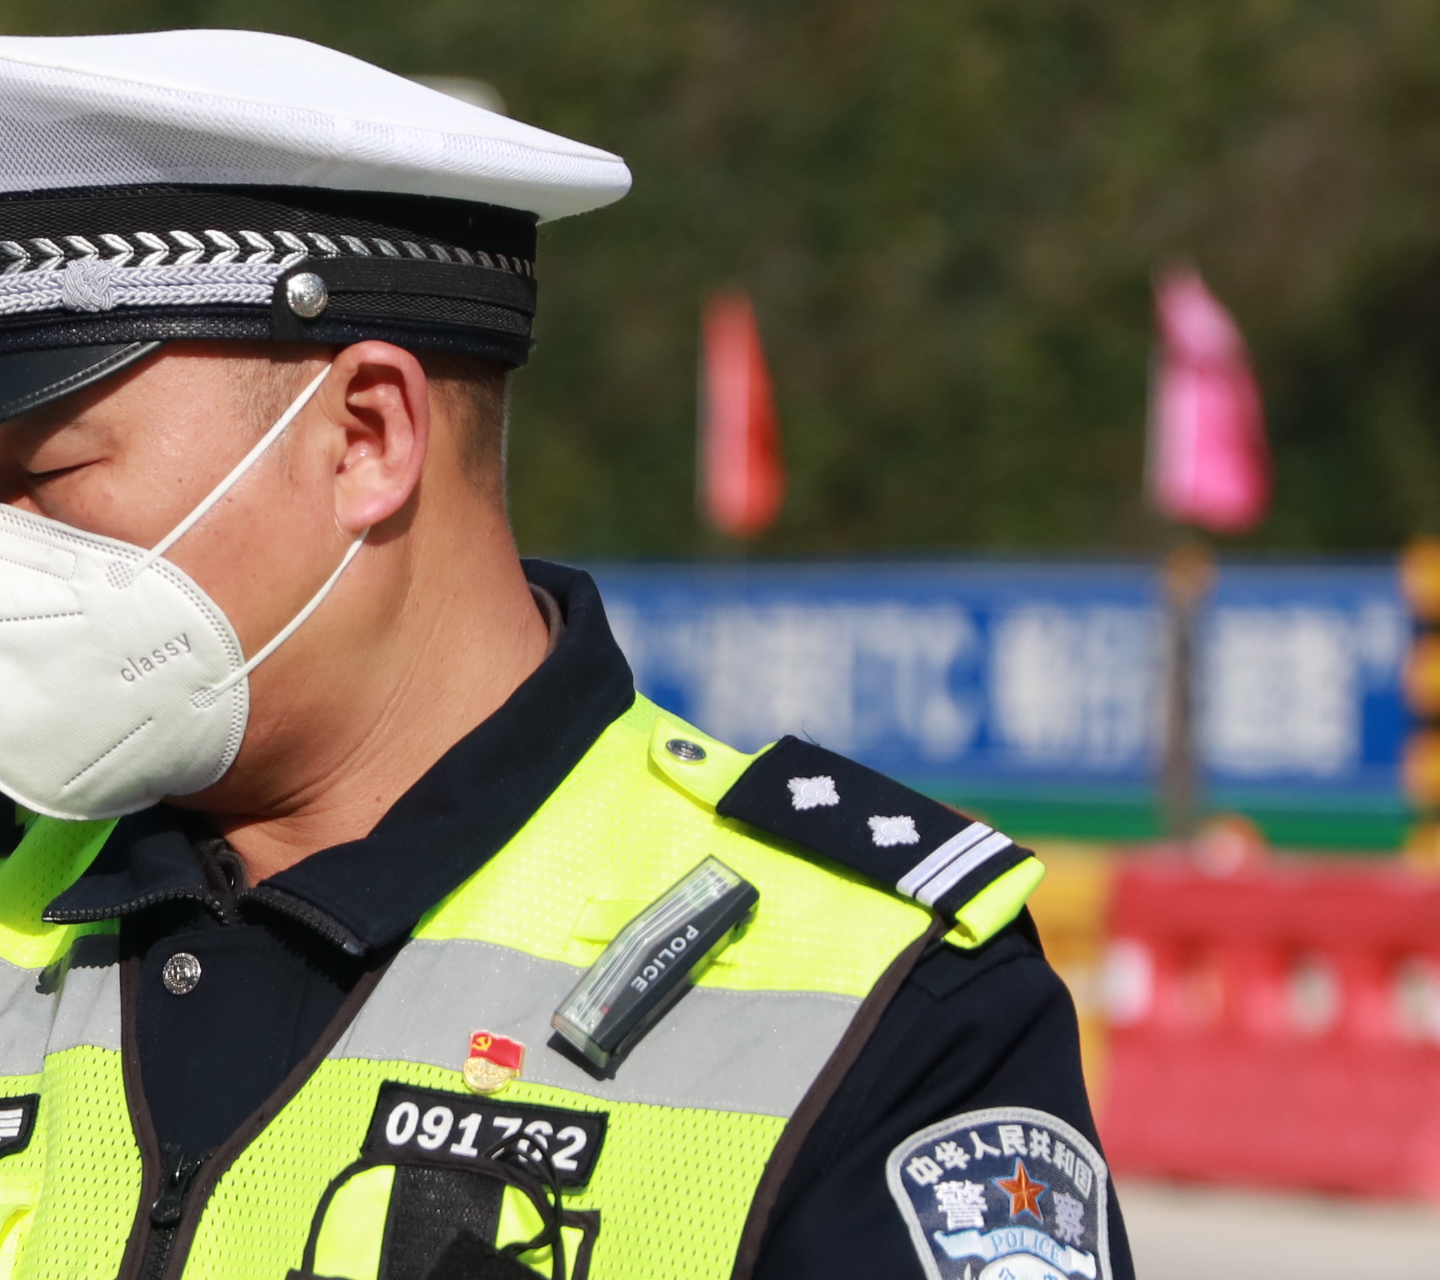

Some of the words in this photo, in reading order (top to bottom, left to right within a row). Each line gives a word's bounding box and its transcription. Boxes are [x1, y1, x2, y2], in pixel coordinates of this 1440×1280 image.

[120, 631, 193, 682] classy
[630, 924, 700, 993] POLICE
[906, 1124, 1093, 1200] 中华人民共和国
[933, 1179, 1086, 1246] 警察
[989, 1231, 1062, 1261] POLICE
